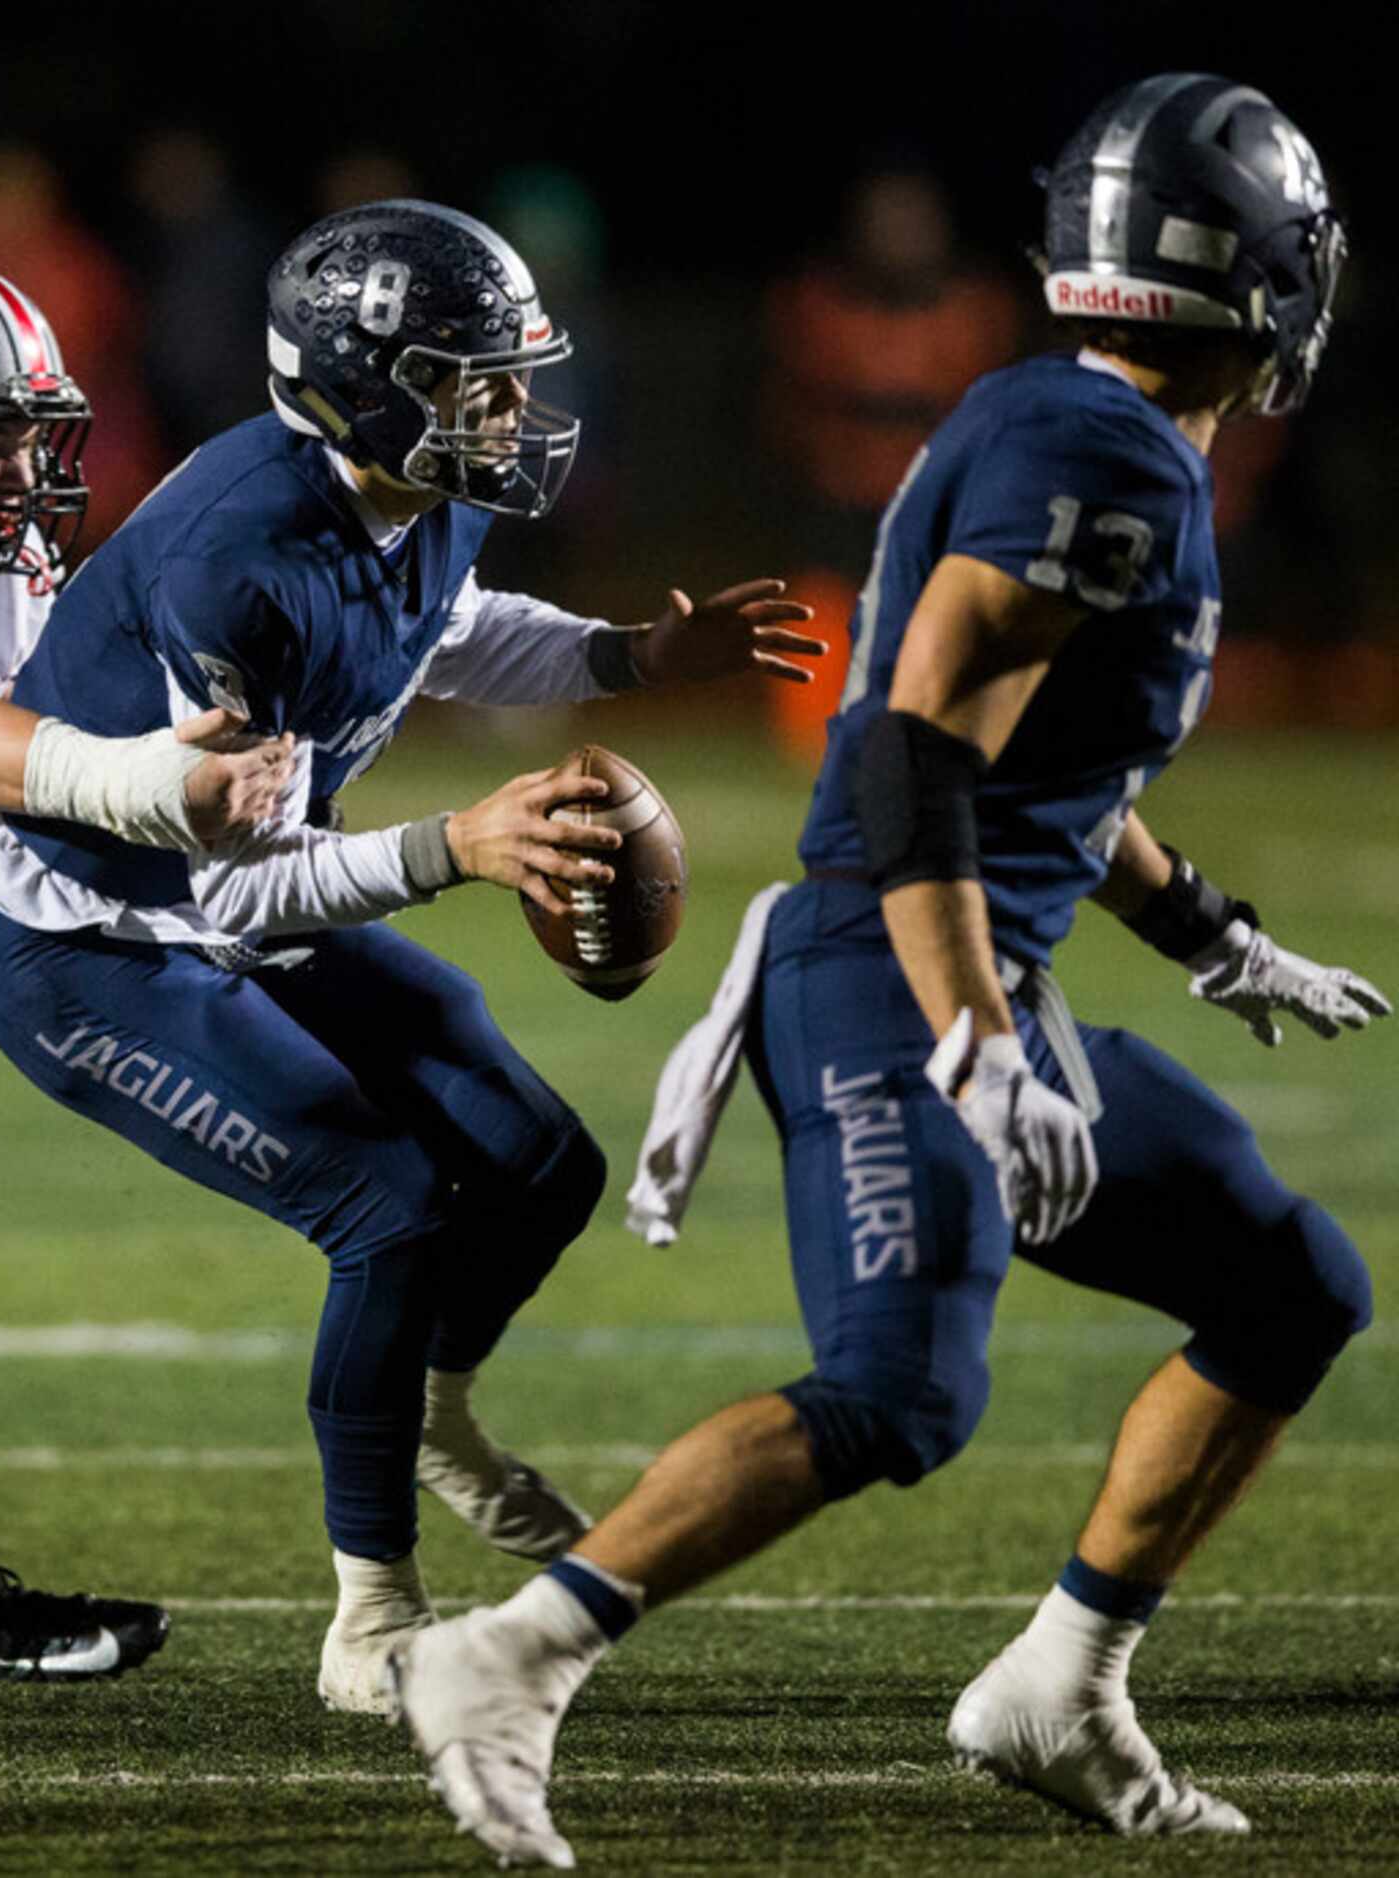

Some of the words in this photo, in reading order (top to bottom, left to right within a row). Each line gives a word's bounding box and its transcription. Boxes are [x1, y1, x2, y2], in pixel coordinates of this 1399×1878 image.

[358, 259, 411, 336] 8
[1057, 279, 1174, 320] Riddell
[1025, 494, 1154, 612] 13
[35, 1025, 292, 1184] JAGUARS
